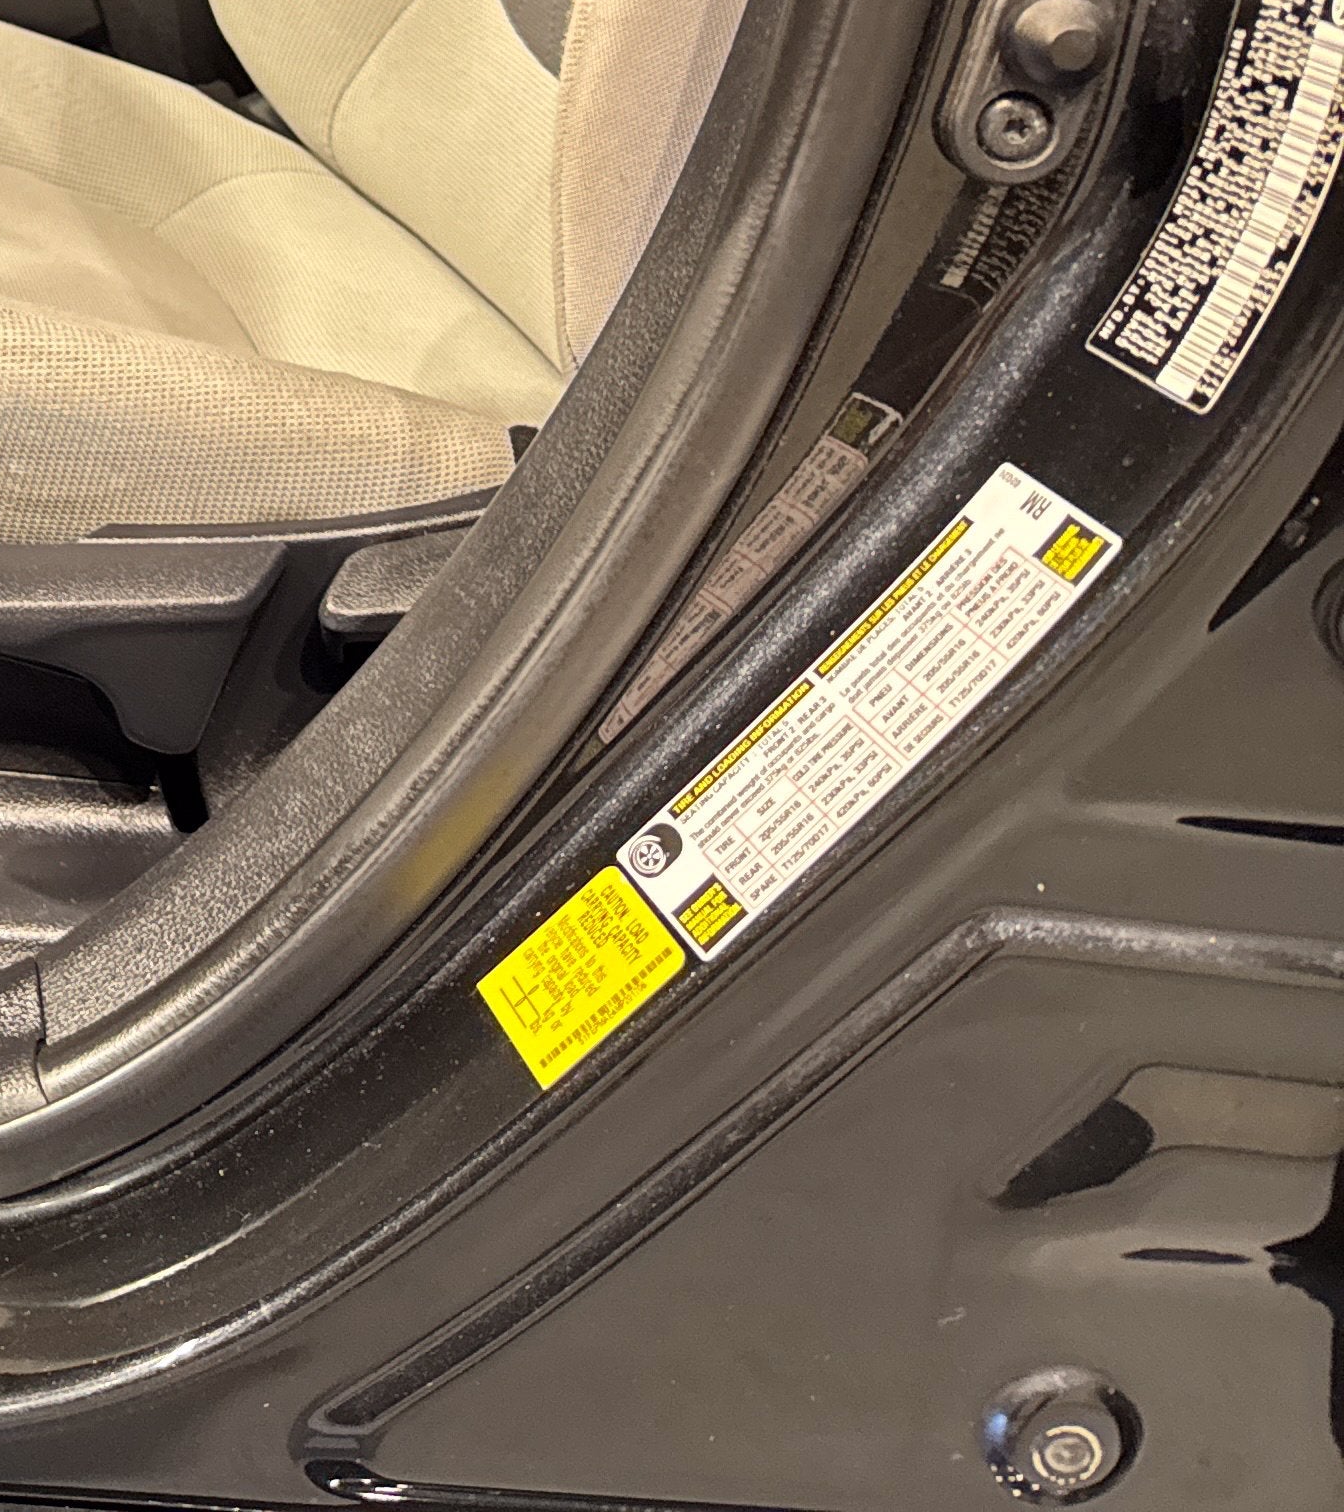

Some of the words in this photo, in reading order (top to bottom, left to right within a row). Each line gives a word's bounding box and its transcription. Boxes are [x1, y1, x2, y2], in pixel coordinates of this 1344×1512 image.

[903, 620, 955, 673] DIMENSIONS
[880, 693, 910, 724] AVANT
[671, 791, 695, 815] TIRE
[690, 773, 715, 796] AND
[710, 737, 753, 778] LOADING
[747, 681, 811, 741] INFORMATION
[714, 834, 736, 856] TIRE
[755, 795, 776, 817] SIZE
[723, 845, 752, 875] FRONT
[737, 860, 763, 886] REAR
[748, 872, 778, 902] SPARE
[575, 909, 610, 950] REDUCED
[578, 887, 615, 930] CARRYING
[605, 922, 643, 967] CAPACITY
[624, 917, 650, 946] LOAD
